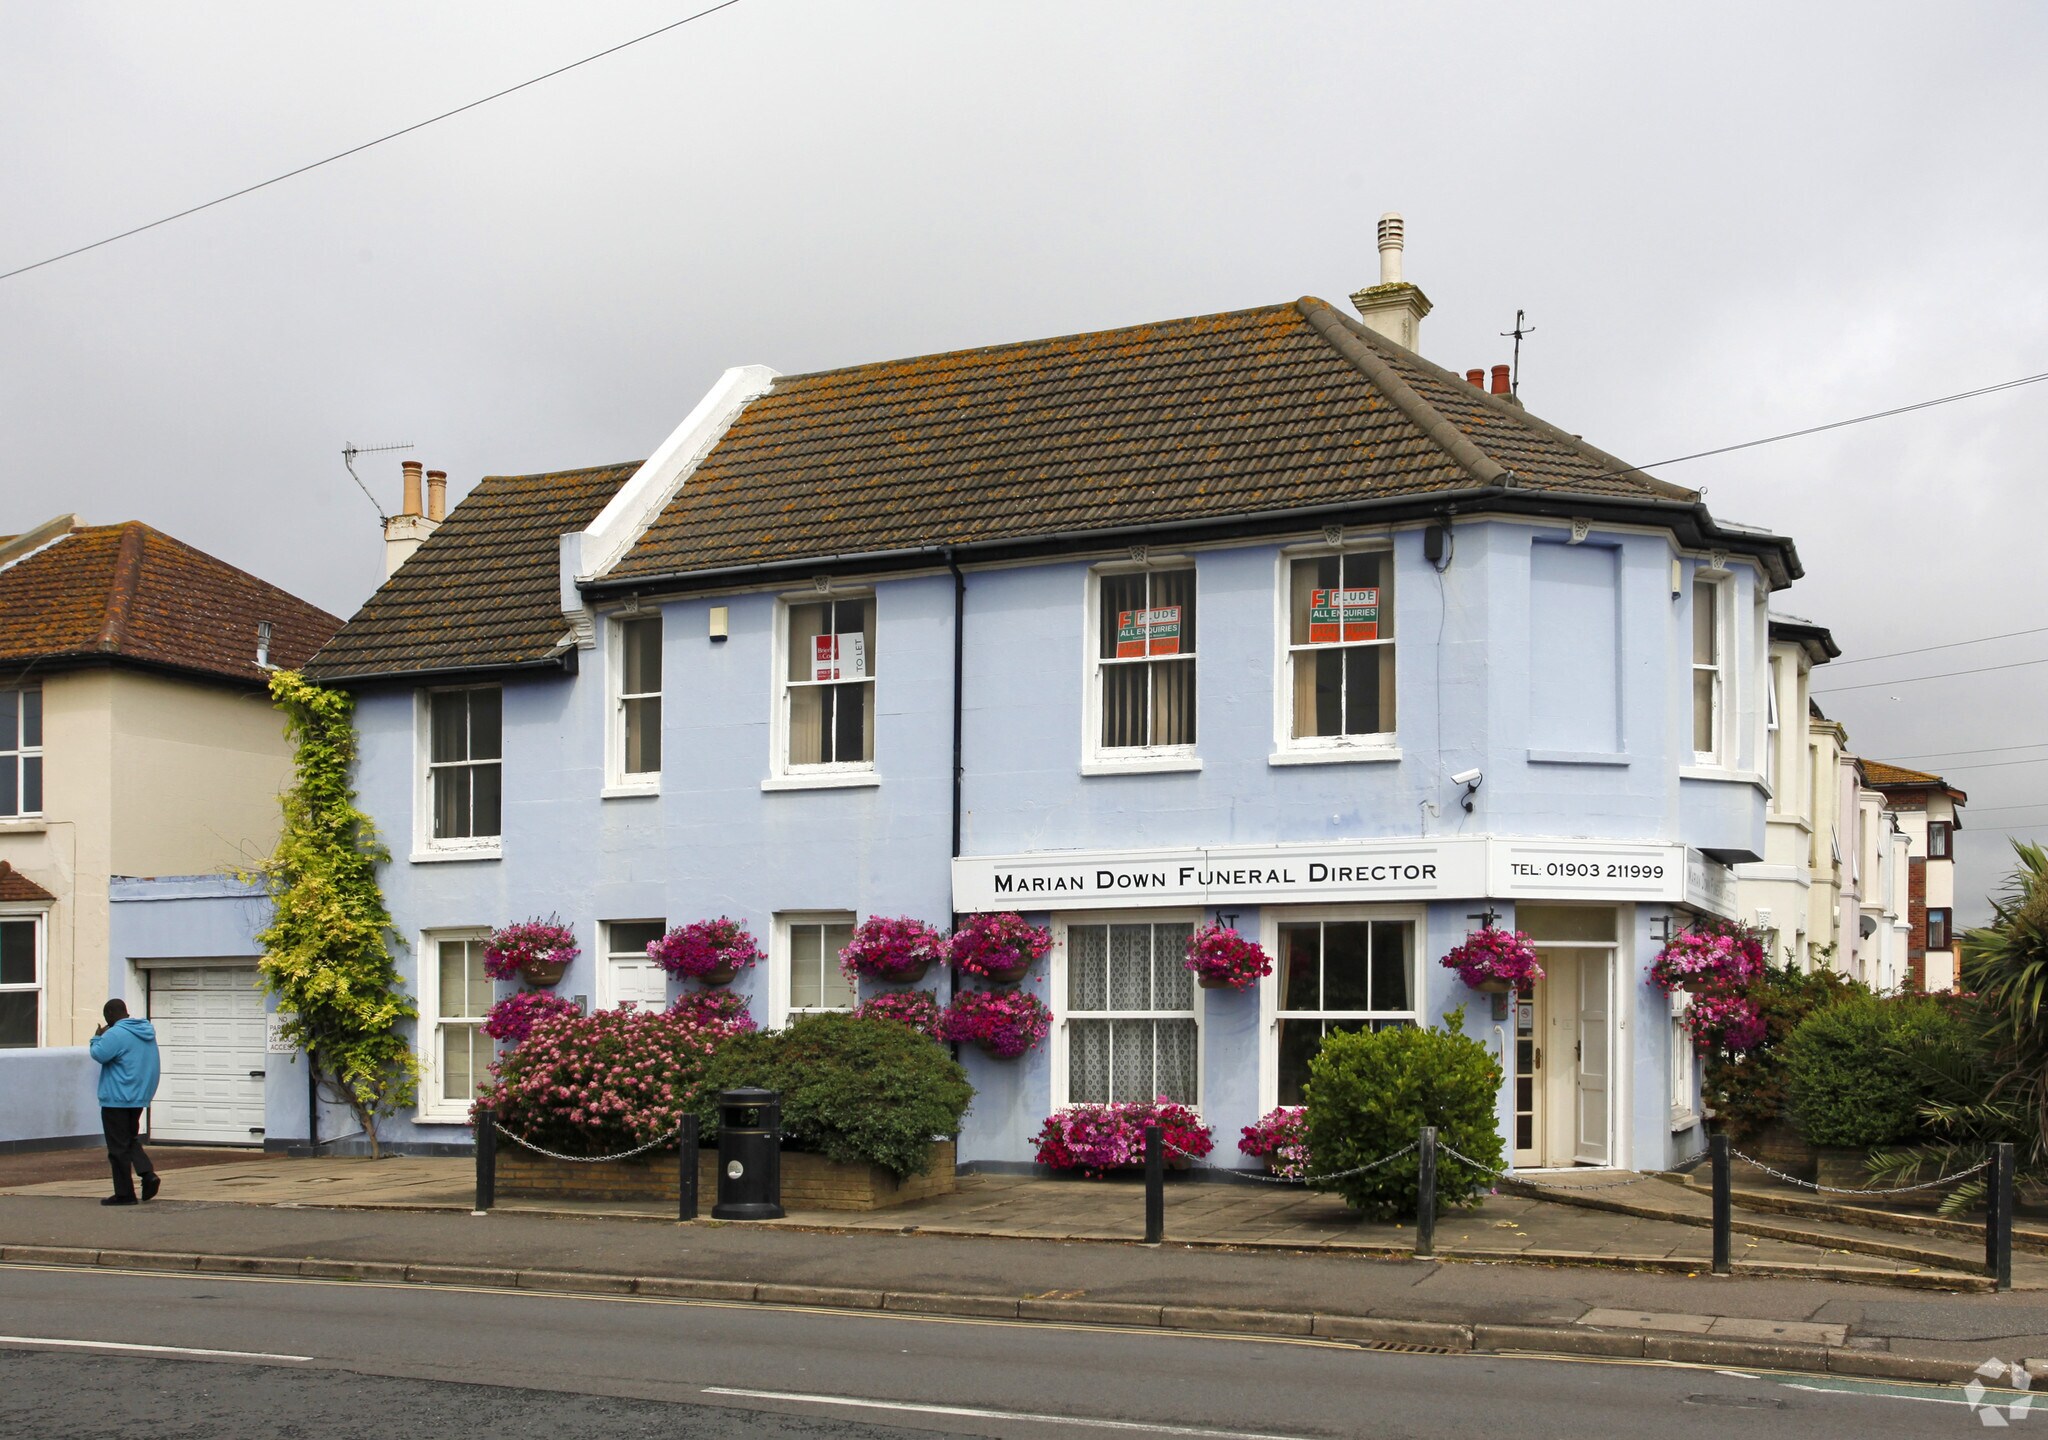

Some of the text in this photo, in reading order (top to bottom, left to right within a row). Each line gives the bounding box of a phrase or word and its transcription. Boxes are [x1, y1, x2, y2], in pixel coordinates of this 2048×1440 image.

[1333, 590, 1374, 602] FLUDE
[1139, 609, 1177, 621] FUDE
[1331, 608, 1376, 617] ENQUIRIES
[1120, 629, 1135, 637] ALL
[1136, 624, 1178, 635] ENQUIRIES
[855, 639, 864, 672] TO LET
[1510, 862, 1664, 879] TEL: 01903 211999
[994, 862, 1437, 893] MARIAN DOWN FUNERAL DIRECTOR
